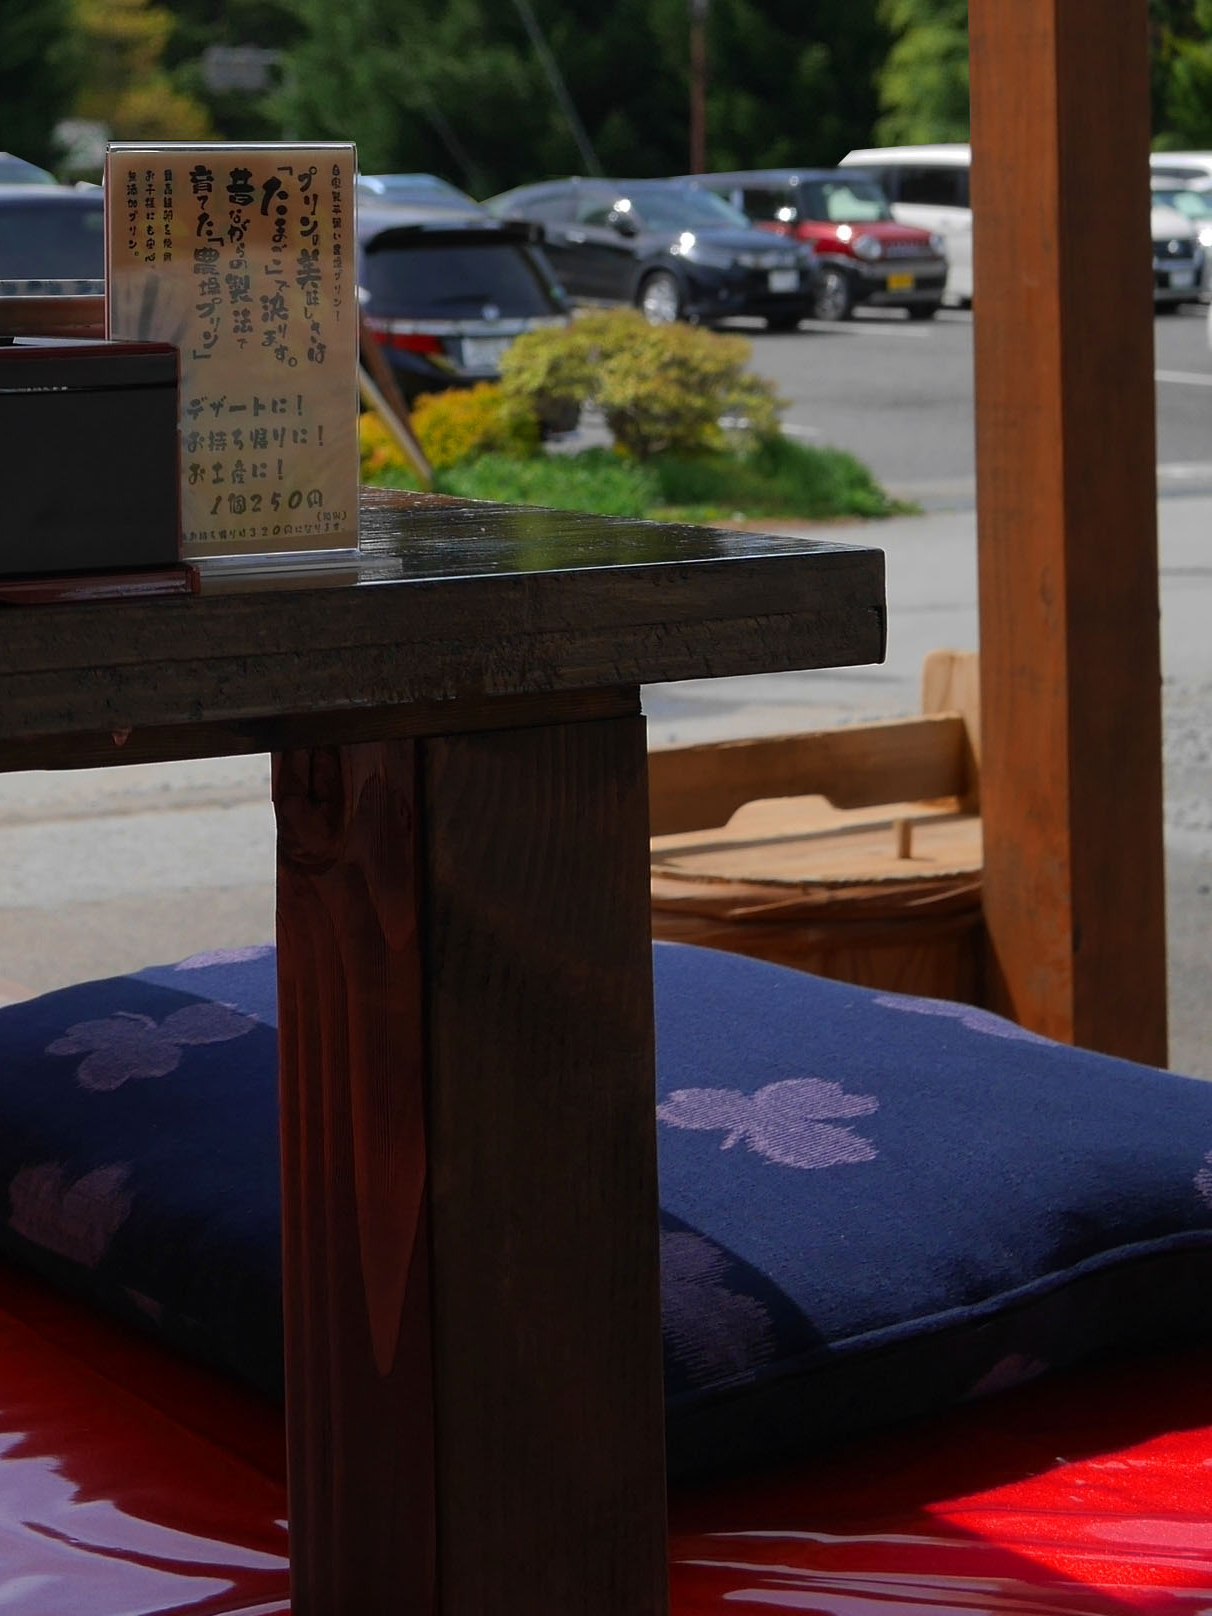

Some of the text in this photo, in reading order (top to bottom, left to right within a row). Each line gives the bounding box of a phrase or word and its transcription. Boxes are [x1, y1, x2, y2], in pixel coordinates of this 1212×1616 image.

[189, 165, 225, 360] 育てた「農場プリン」
[225, 167, 256, 350] 昔ながらの製法で
